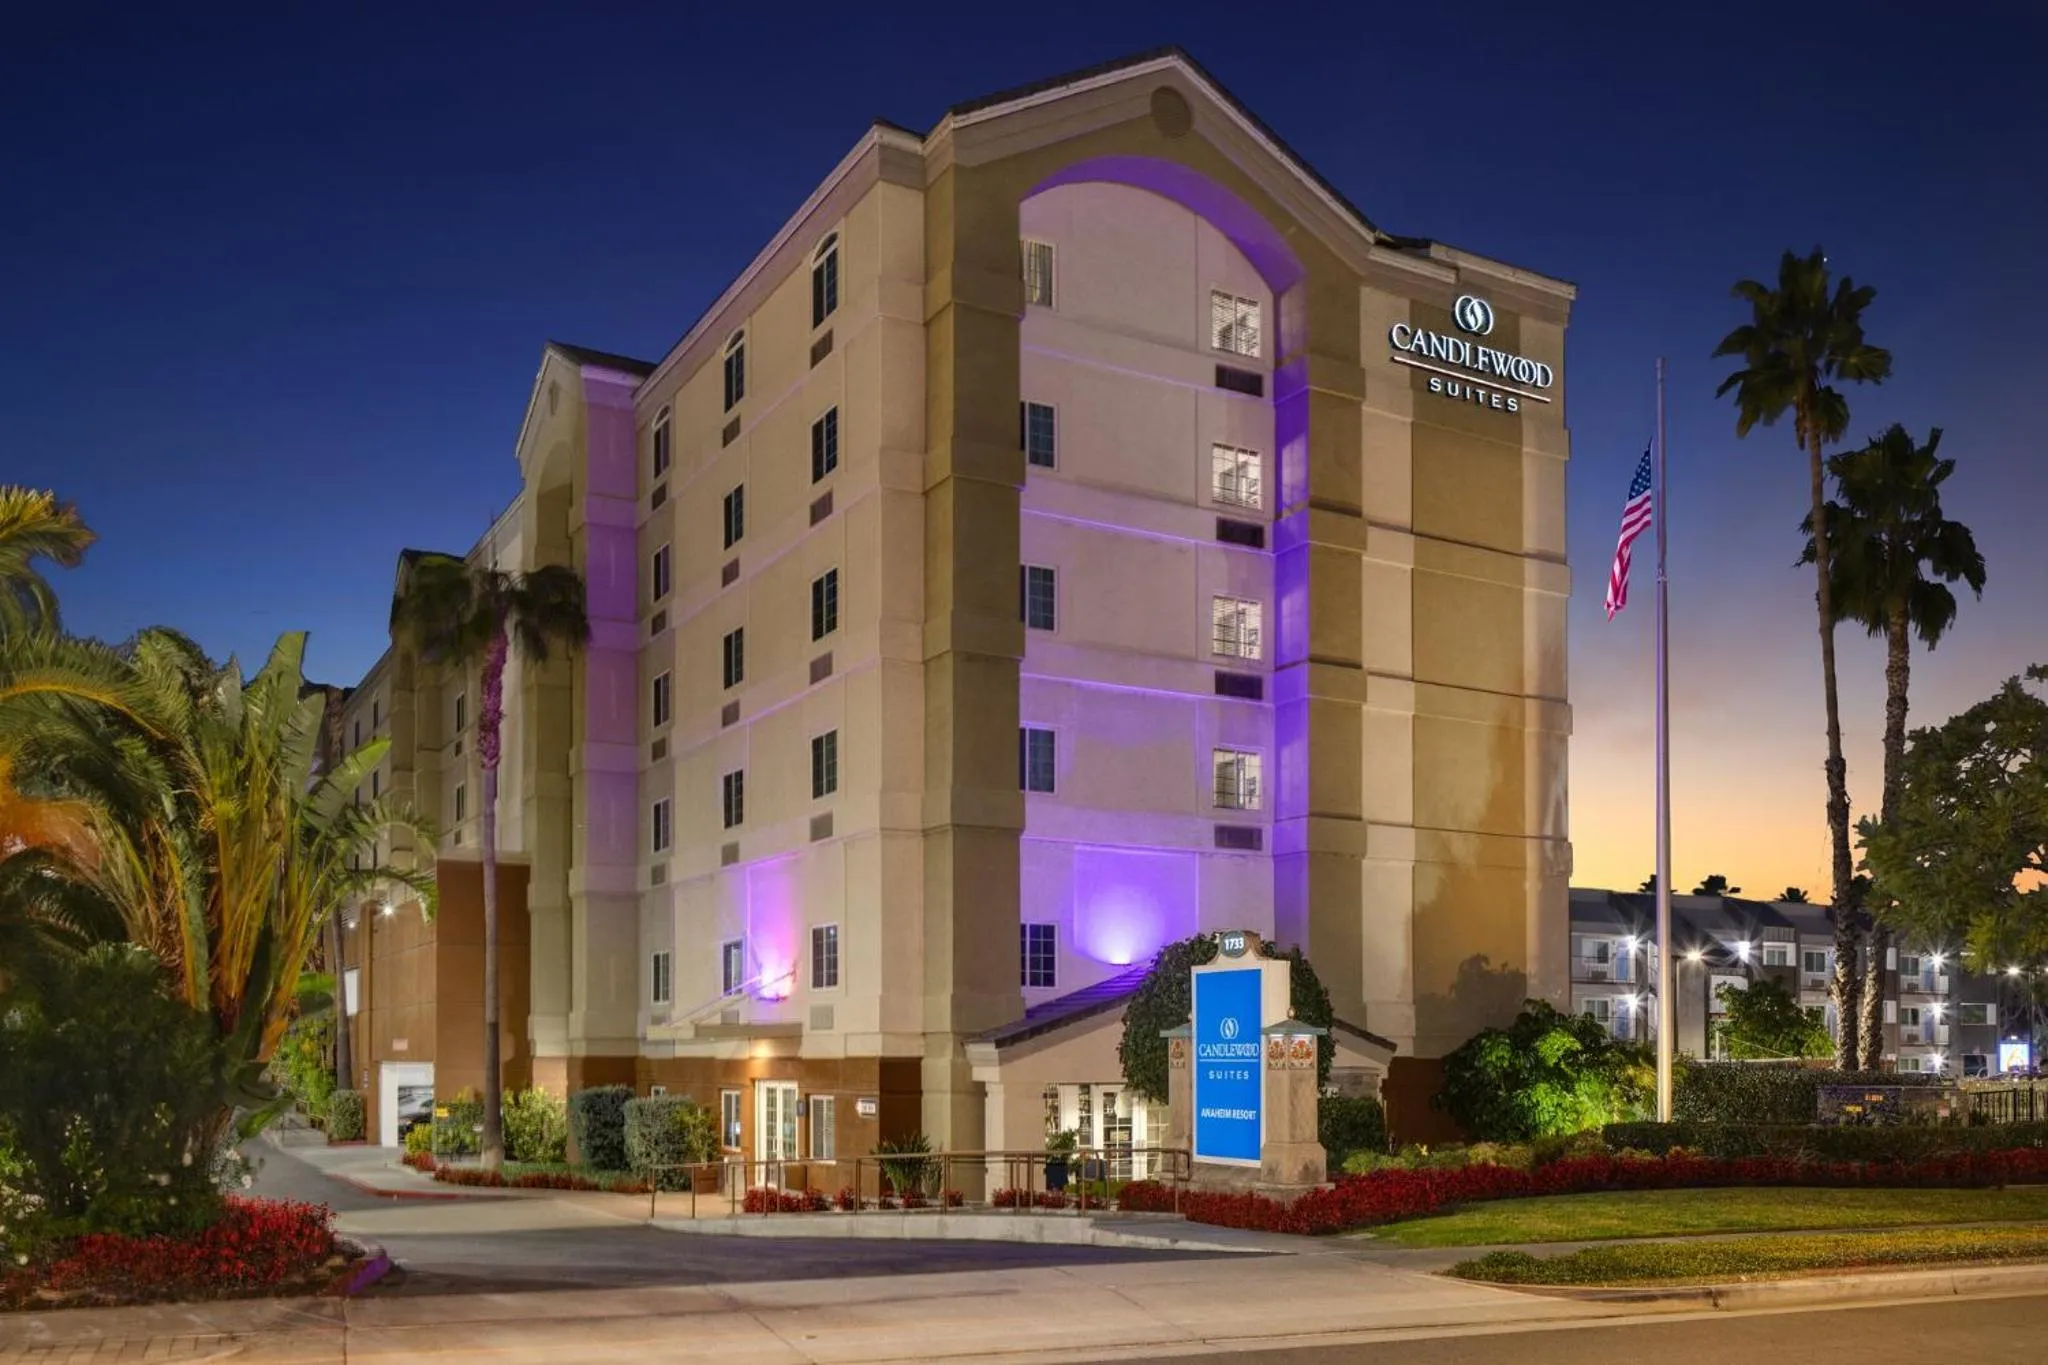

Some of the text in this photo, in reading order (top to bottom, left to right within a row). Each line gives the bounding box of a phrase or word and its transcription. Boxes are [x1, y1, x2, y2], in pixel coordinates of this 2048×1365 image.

[1391, 323, 1553, 388] CANDLEWOOD
[1429, 377, 1518, 412] SUITES
[1225, 937, 1244, 950] 1733
[1199, 1043, 1259, 1057] CANDLEWOOD
[1209, 1070, 1249, 1080] SUITES
[1201, 1108, 1256, 1119] ANAHEIM RESORT
